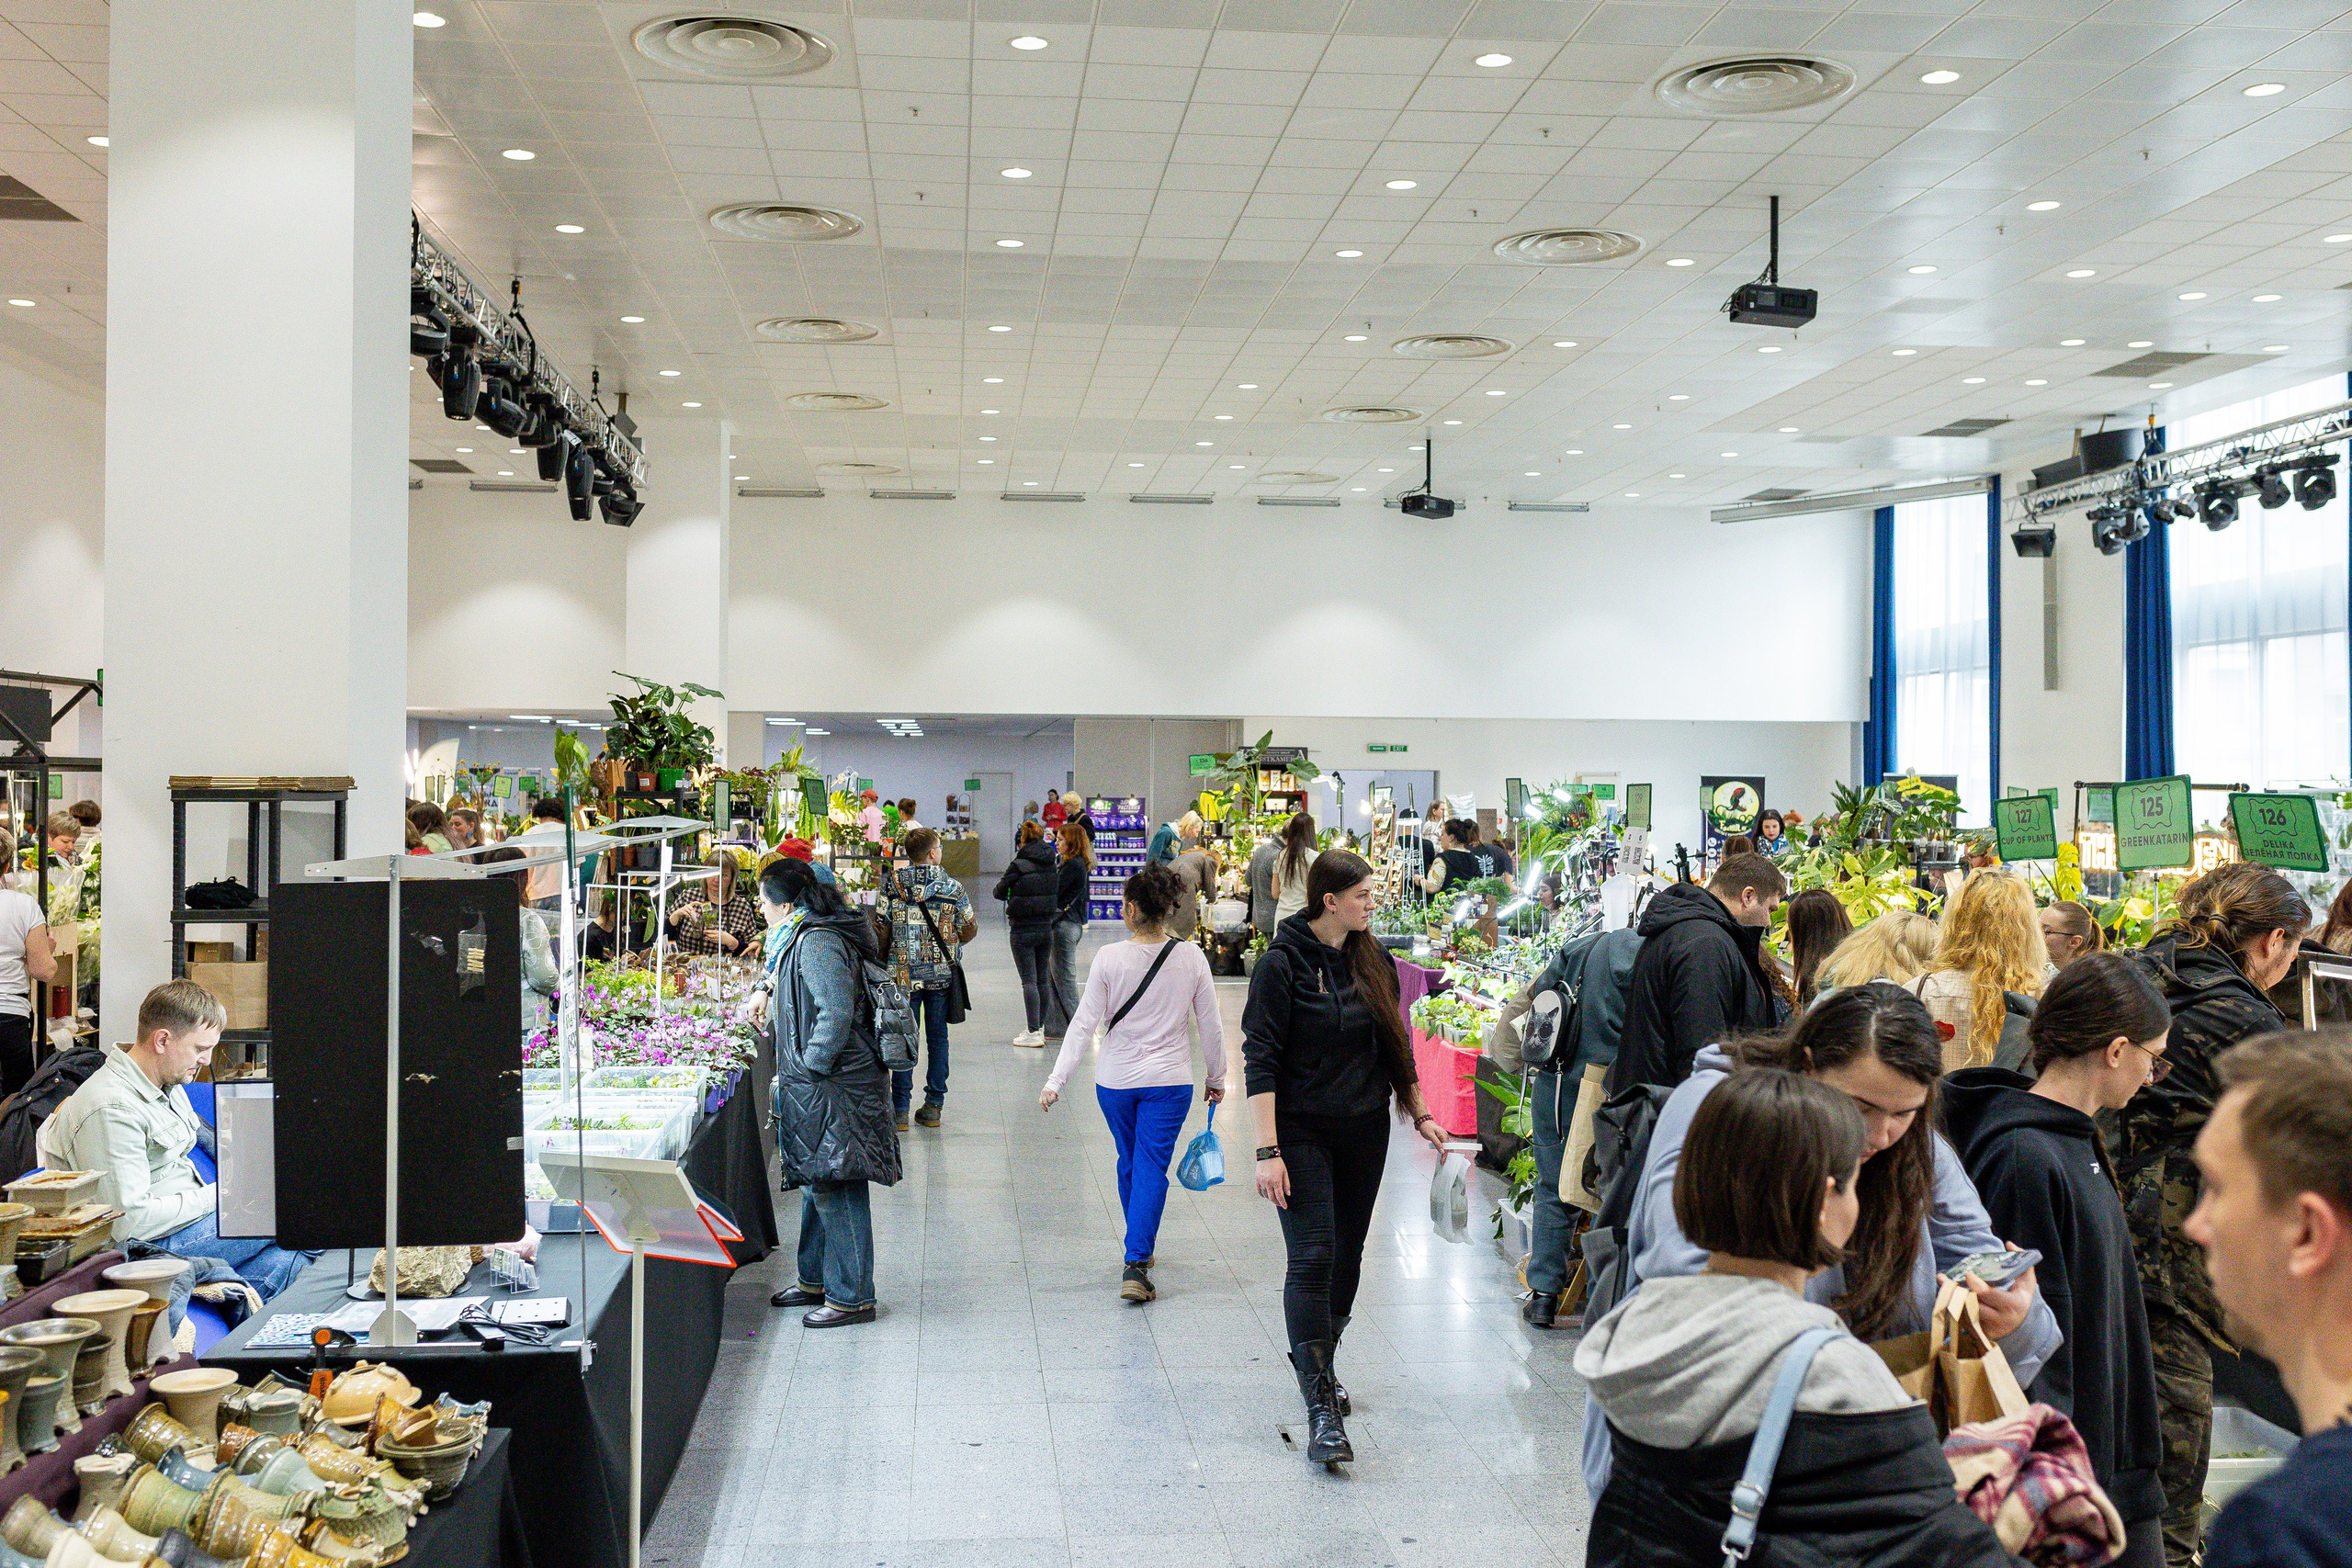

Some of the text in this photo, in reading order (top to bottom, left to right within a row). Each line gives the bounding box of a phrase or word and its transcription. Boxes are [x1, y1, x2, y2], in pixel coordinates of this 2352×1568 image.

[2140, 796, 2164, 817] 125
[2015, 809, 2032, 824] 127
[2259, 808, 2287, 826] 126
[2001, 834, 2054, 845] CUP OF PLANTS
[2120, 832, 2188, 848] GREENKATARIN
[2263, 840, 2295, 850] DELIKA
[2287, 851, 2321, 862] ПОЛКА
